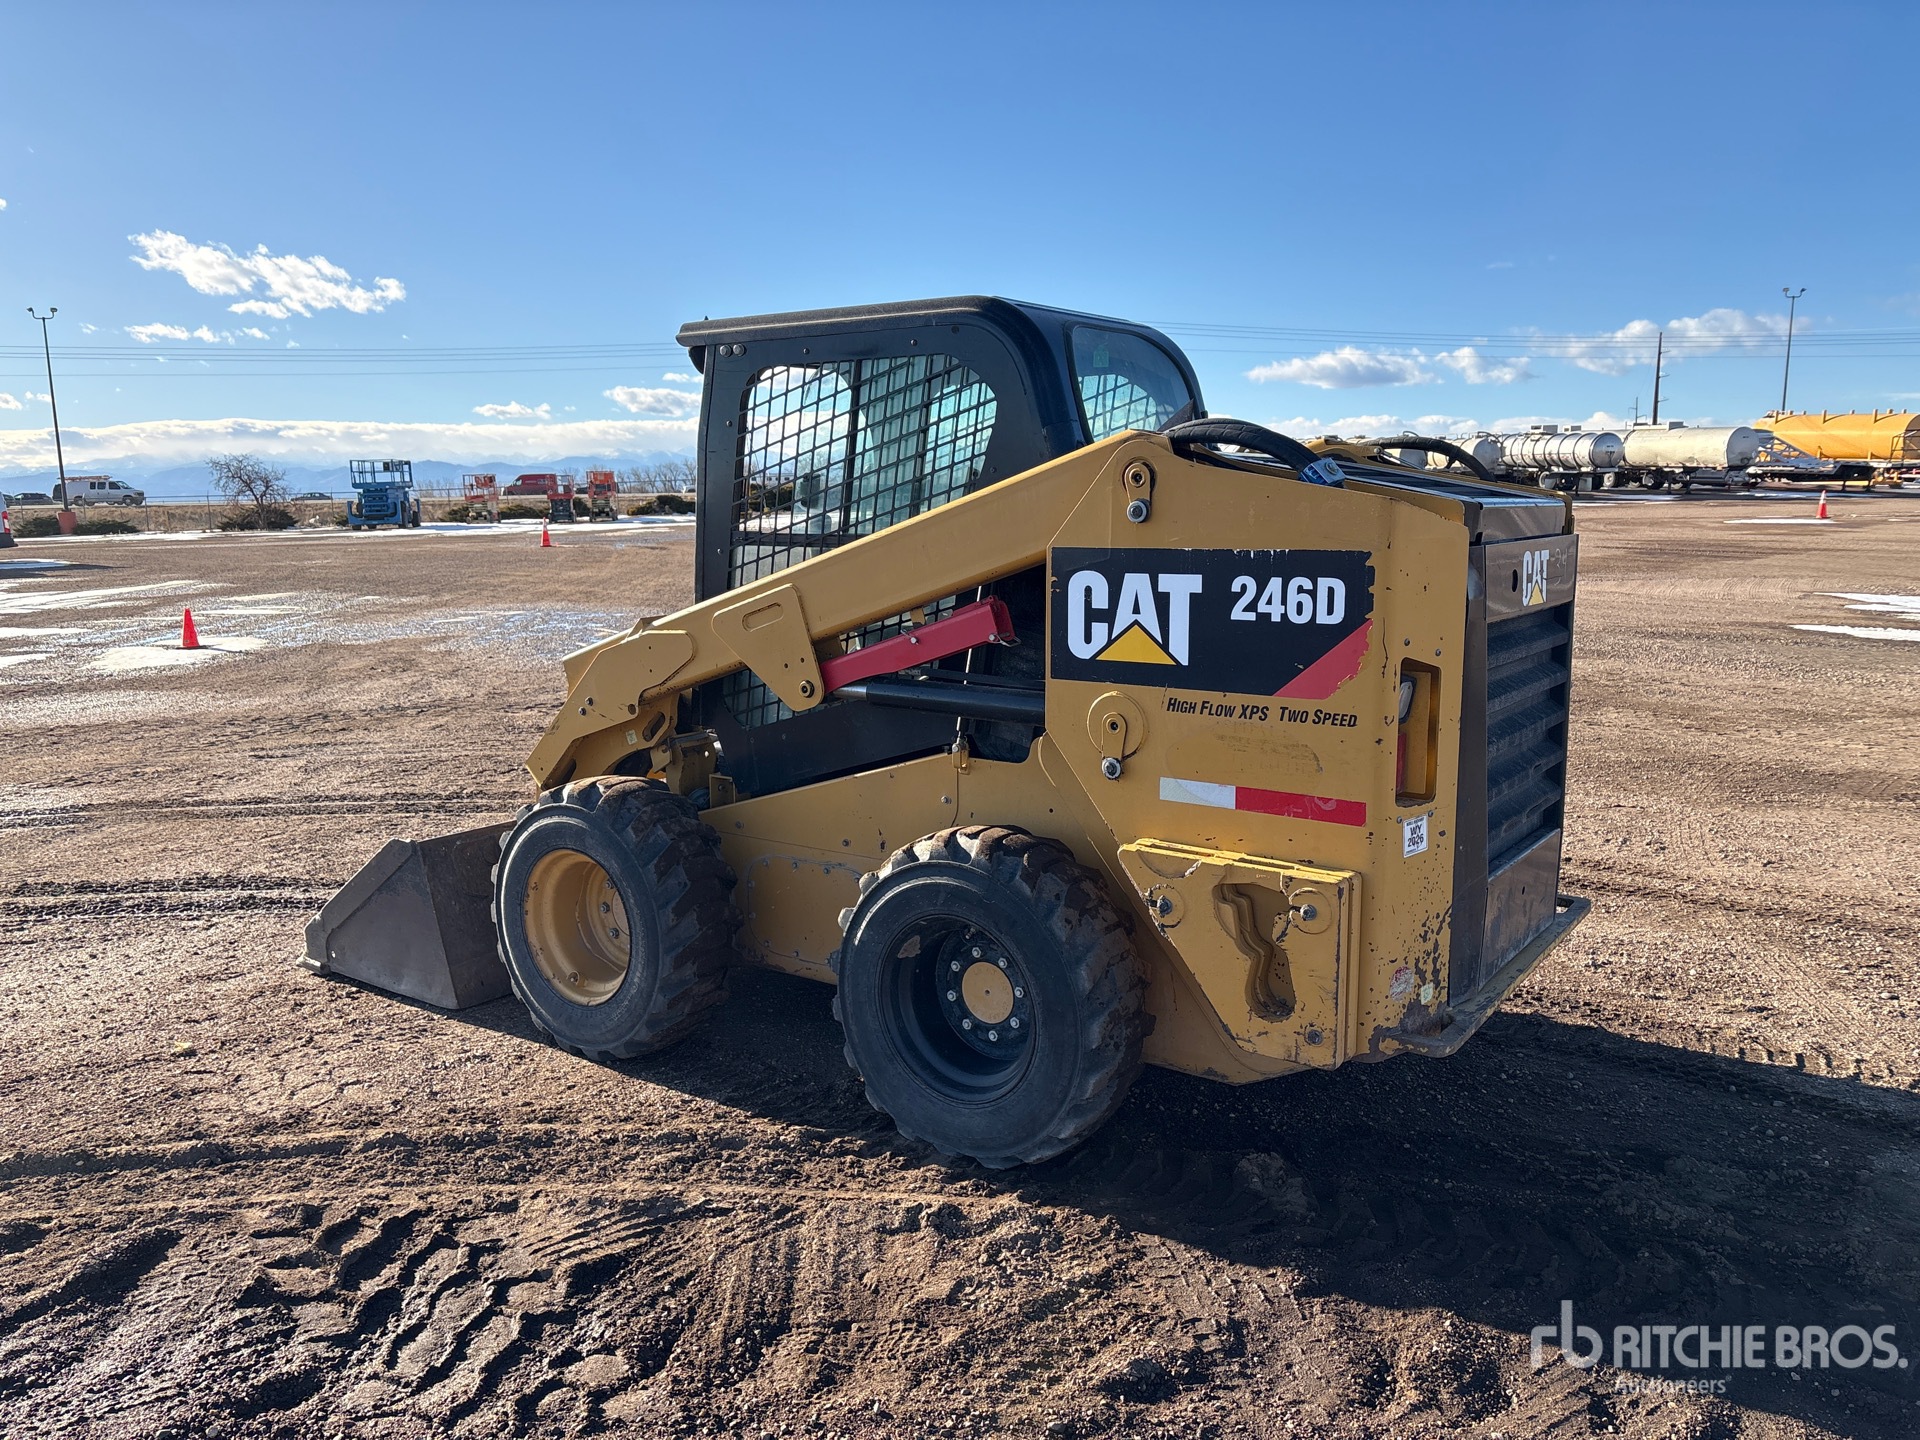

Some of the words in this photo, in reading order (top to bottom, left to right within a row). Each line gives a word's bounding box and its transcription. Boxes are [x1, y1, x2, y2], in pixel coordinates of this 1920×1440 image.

[1230, 575, 1346, 625] 246D
[1522, 549, 1549, 607] CAT
[1067, 570, 1203, 666] CAT
[1166, 697, 1197, 715] HIGH
[1200, 700, 1236, 718] FLOW
[1238, 704, 1269, 721] XPS
[1279, 706, 1309, 724] TWO
[1312, 709, 1358, 727] SPEED
[1407, 833, 1424, 847] 2026
